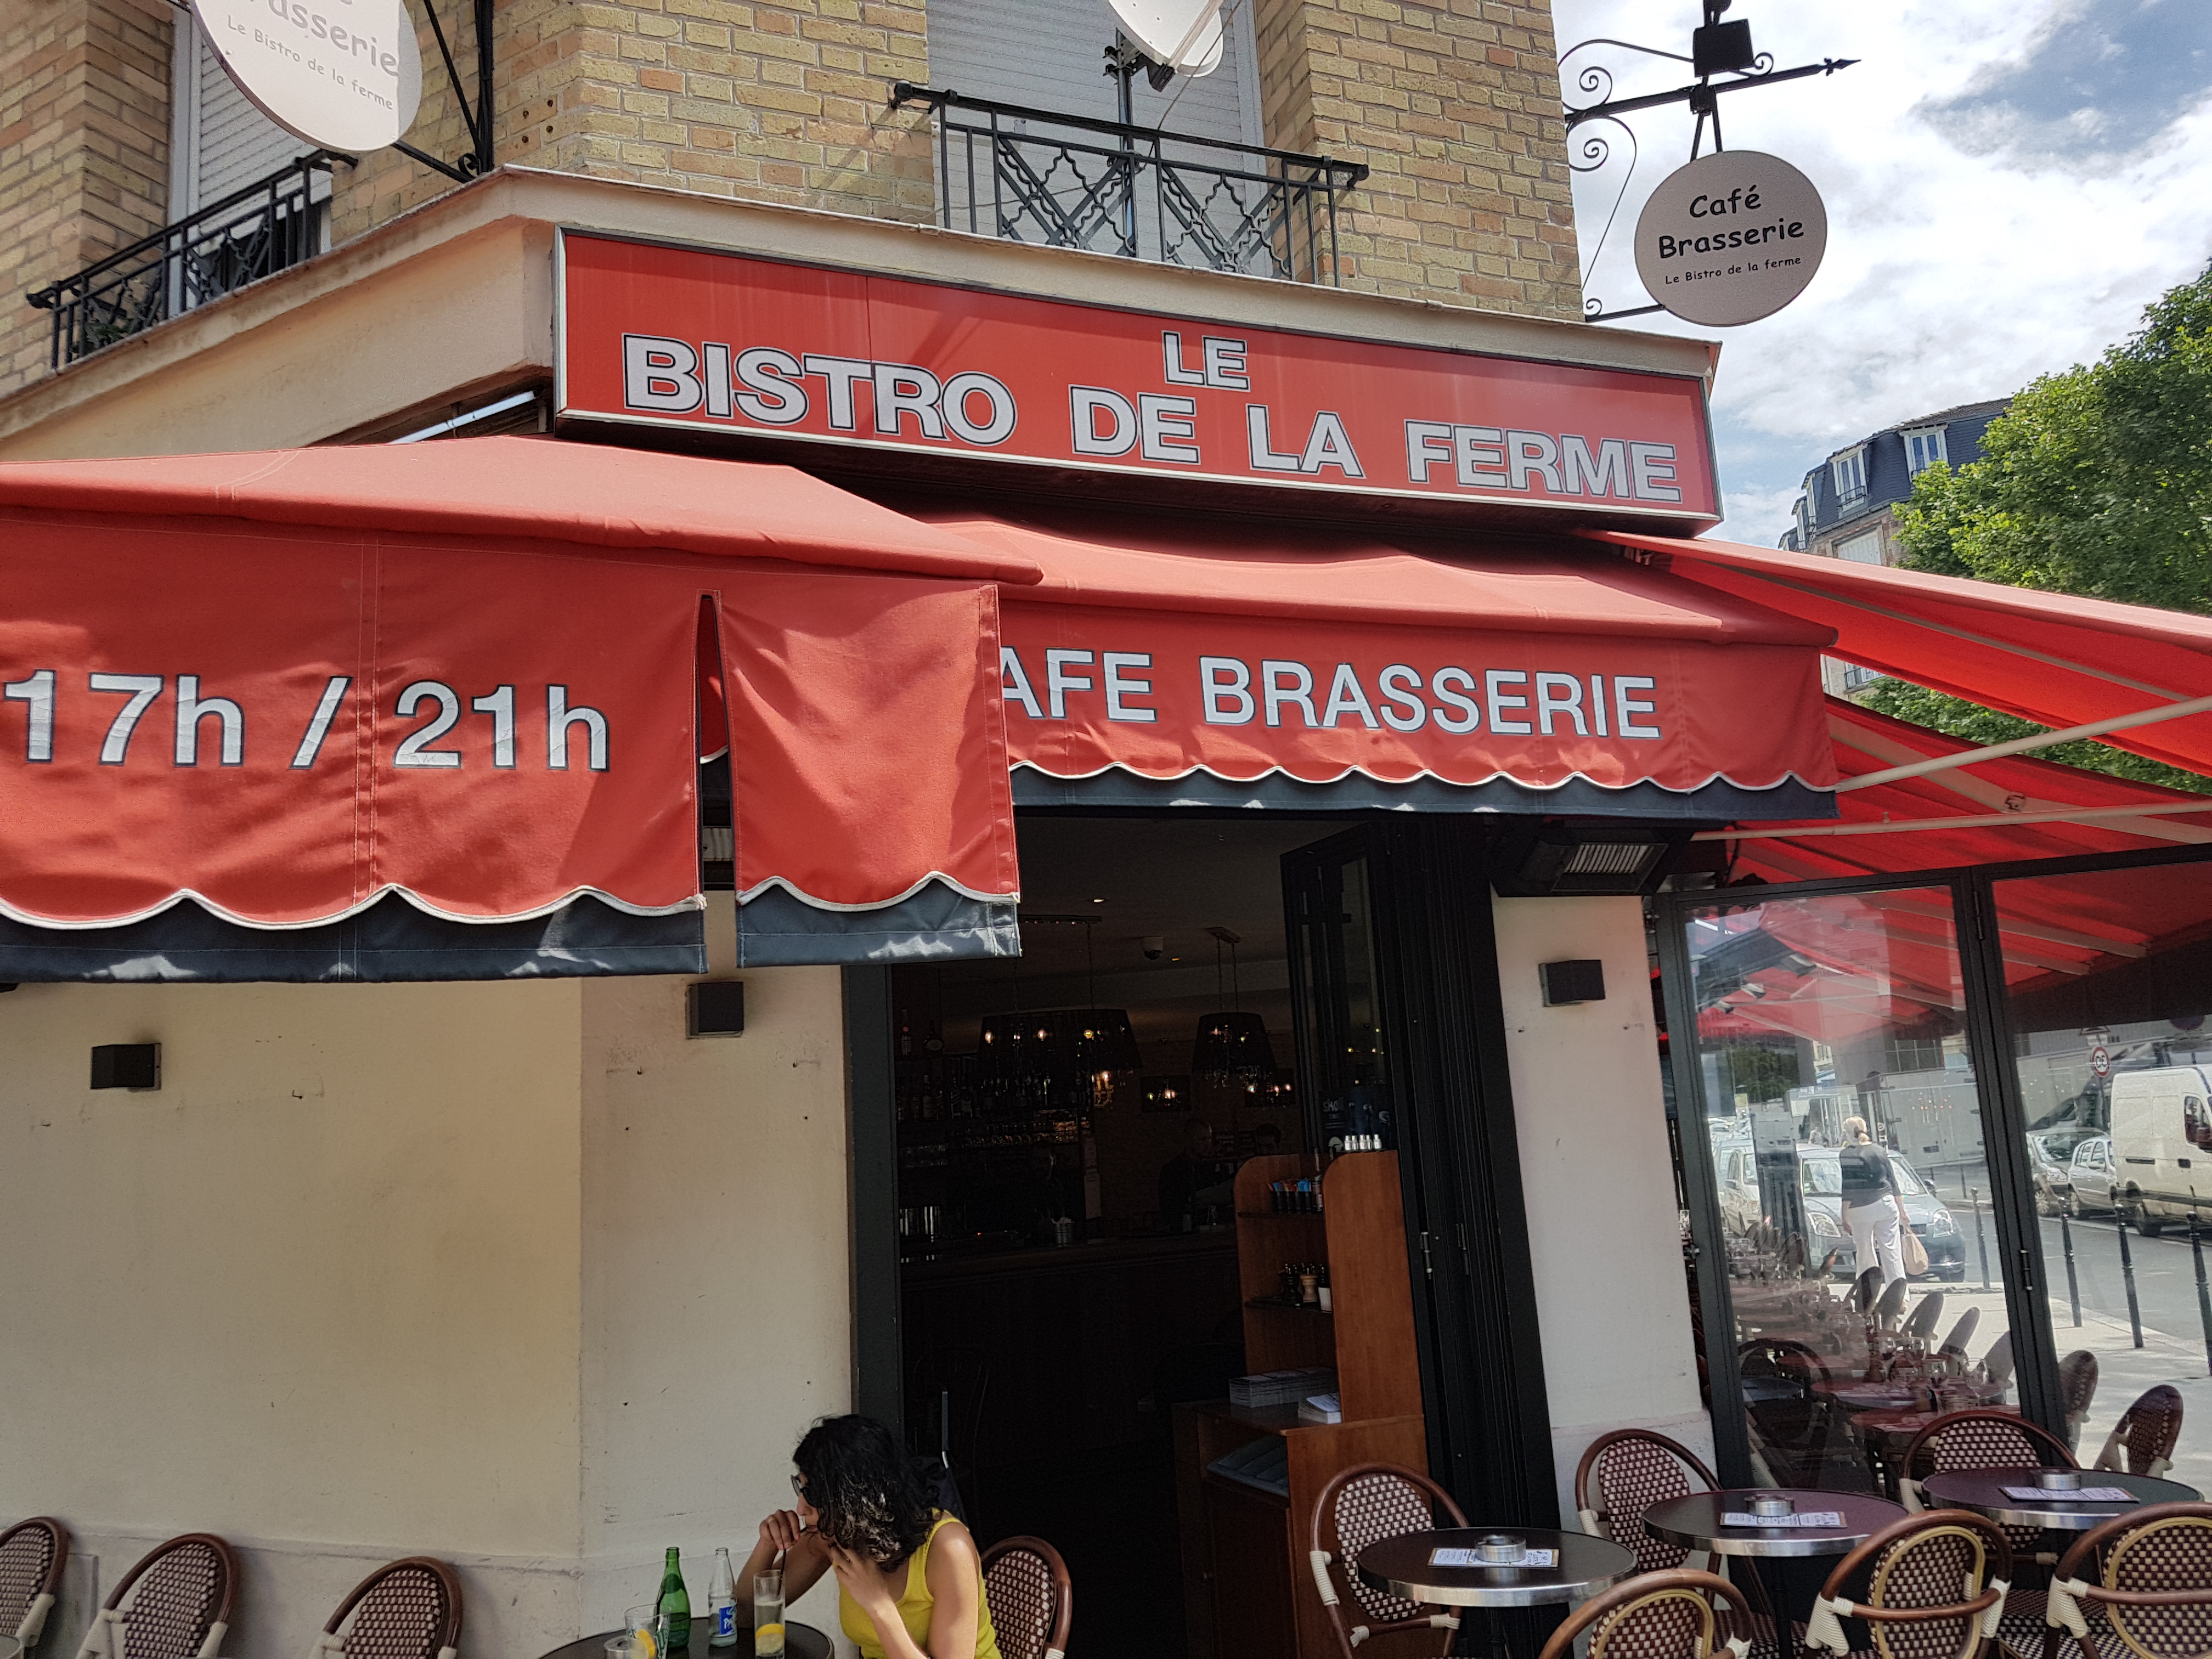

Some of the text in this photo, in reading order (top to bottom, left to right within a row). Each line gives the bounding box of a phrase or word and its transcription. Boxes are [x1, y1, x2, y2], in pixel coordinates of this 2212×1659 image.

[228, 15, 393, 110] Le Bistro de la ferme
[250, 0, 399, 76] asserie
[1658, 218, 1804, 259] Brasserie
[1689, 184, 1762, 218] Café
[1665, 257, 1802, 285] Le Bistro de la ferme
[1161, 329, 1251, 392] LE
[621, 332, 1683, 504] BISTRO DE LA FERME
[3, 668, 611, 772] 17h / 21h
[1001, 645, 1662, 740] AFE BRASSERIE
